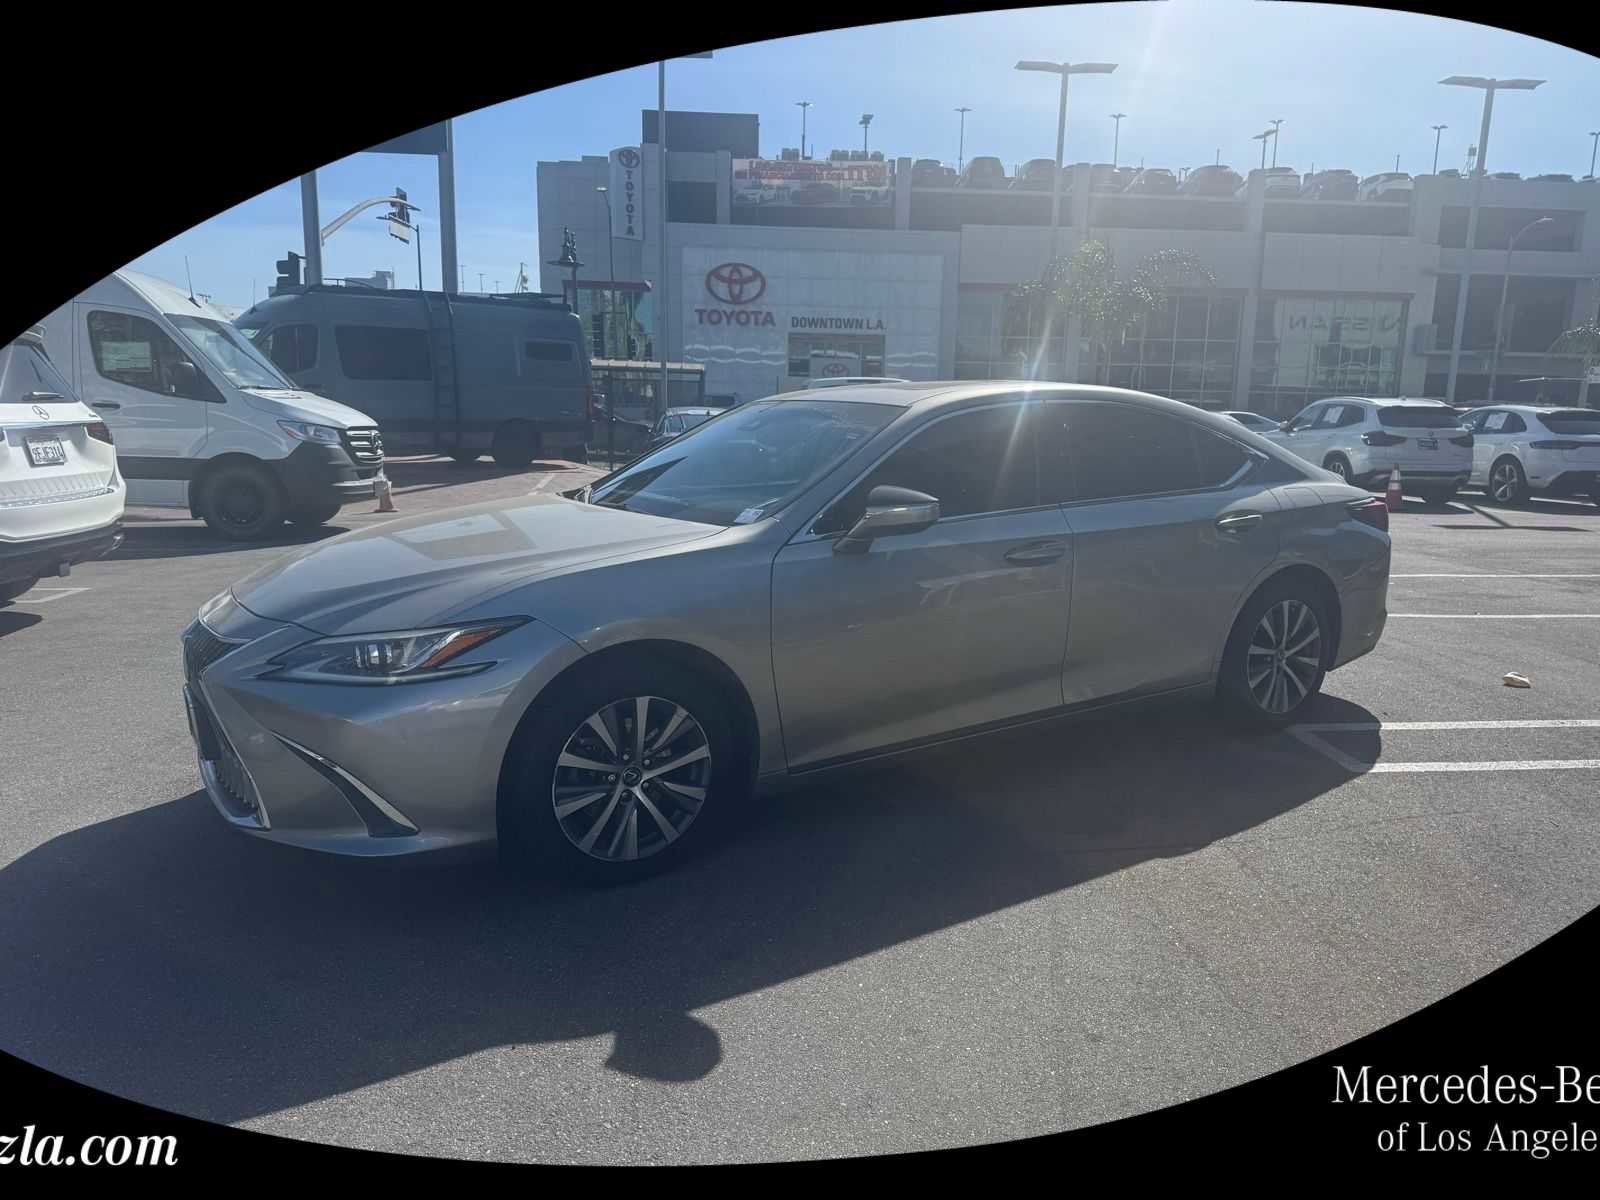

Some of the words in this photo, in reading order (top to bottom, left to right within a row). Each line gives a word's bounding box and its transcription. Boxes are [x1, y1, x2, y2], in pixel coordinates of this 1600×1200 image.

[625, 169, 635, 236] TOYOTA
[695, 309, 776, 327] TOYOTA
[791, 316, 863, 329] DOWNTOWN
[866, 319, 887, 330] L.A.
